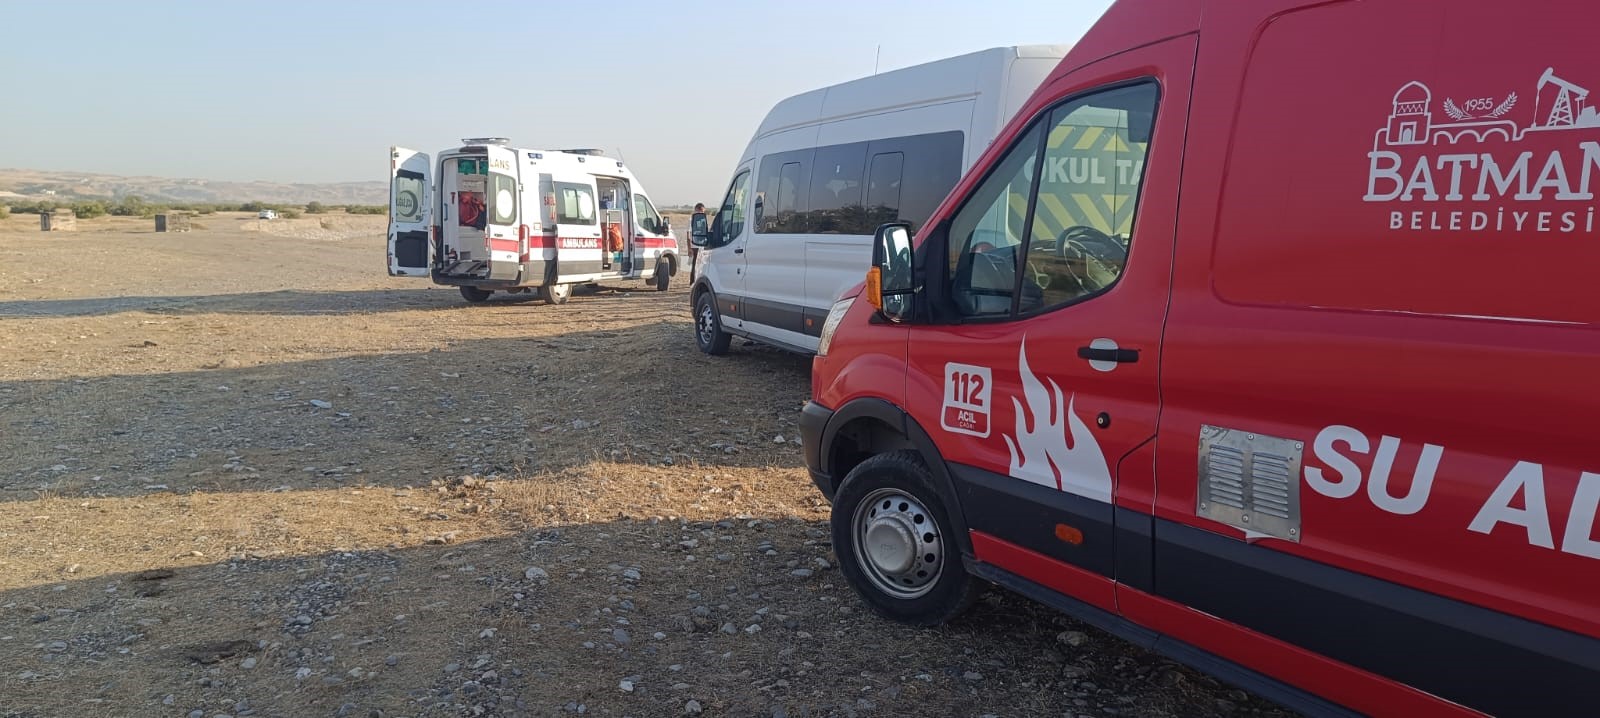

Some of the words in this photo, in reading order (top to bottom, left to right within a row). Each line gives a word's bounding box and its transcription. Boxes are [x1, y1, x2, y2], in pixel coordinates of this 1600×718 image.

[1464, 97, 1494, 112] 1955
[1390, 206, 1594, 233] BELEDİYESİ
[562, 237, 598, 249] AMBULANS
[951, 371, 985, 407] 112
[1304, 424, 1445, 515] SU
